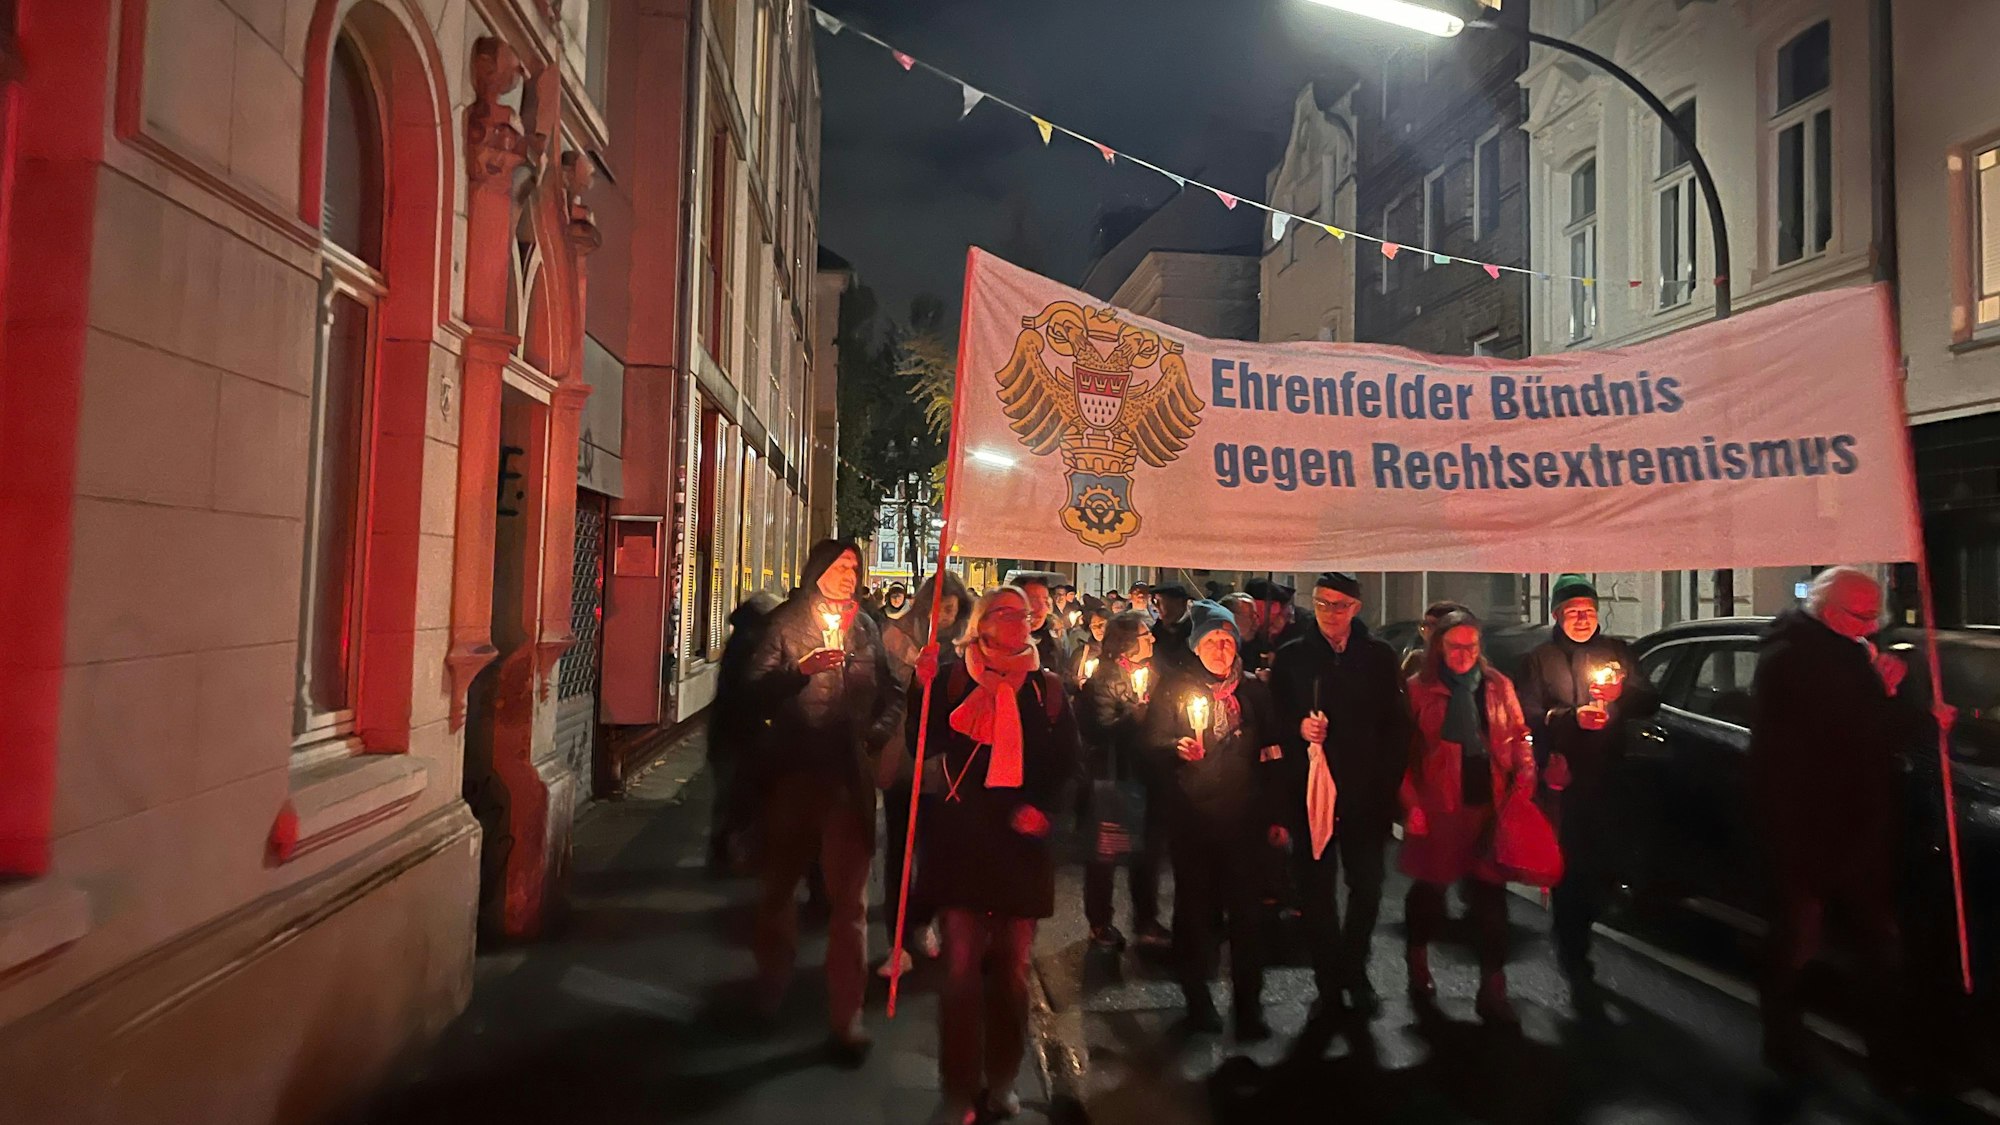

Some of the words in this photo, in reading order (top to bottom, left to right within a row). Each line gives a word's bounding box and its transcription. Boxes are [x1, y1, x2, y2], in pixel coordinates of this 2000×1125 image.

[1212, 358, 1473, 421] Ehrenfelder
[1491, 370, 1683, 421] Bündnis
[1214, 442, 1355, 491] gegen
[1372, 434, 1857, 491] Rechtsextremismus
